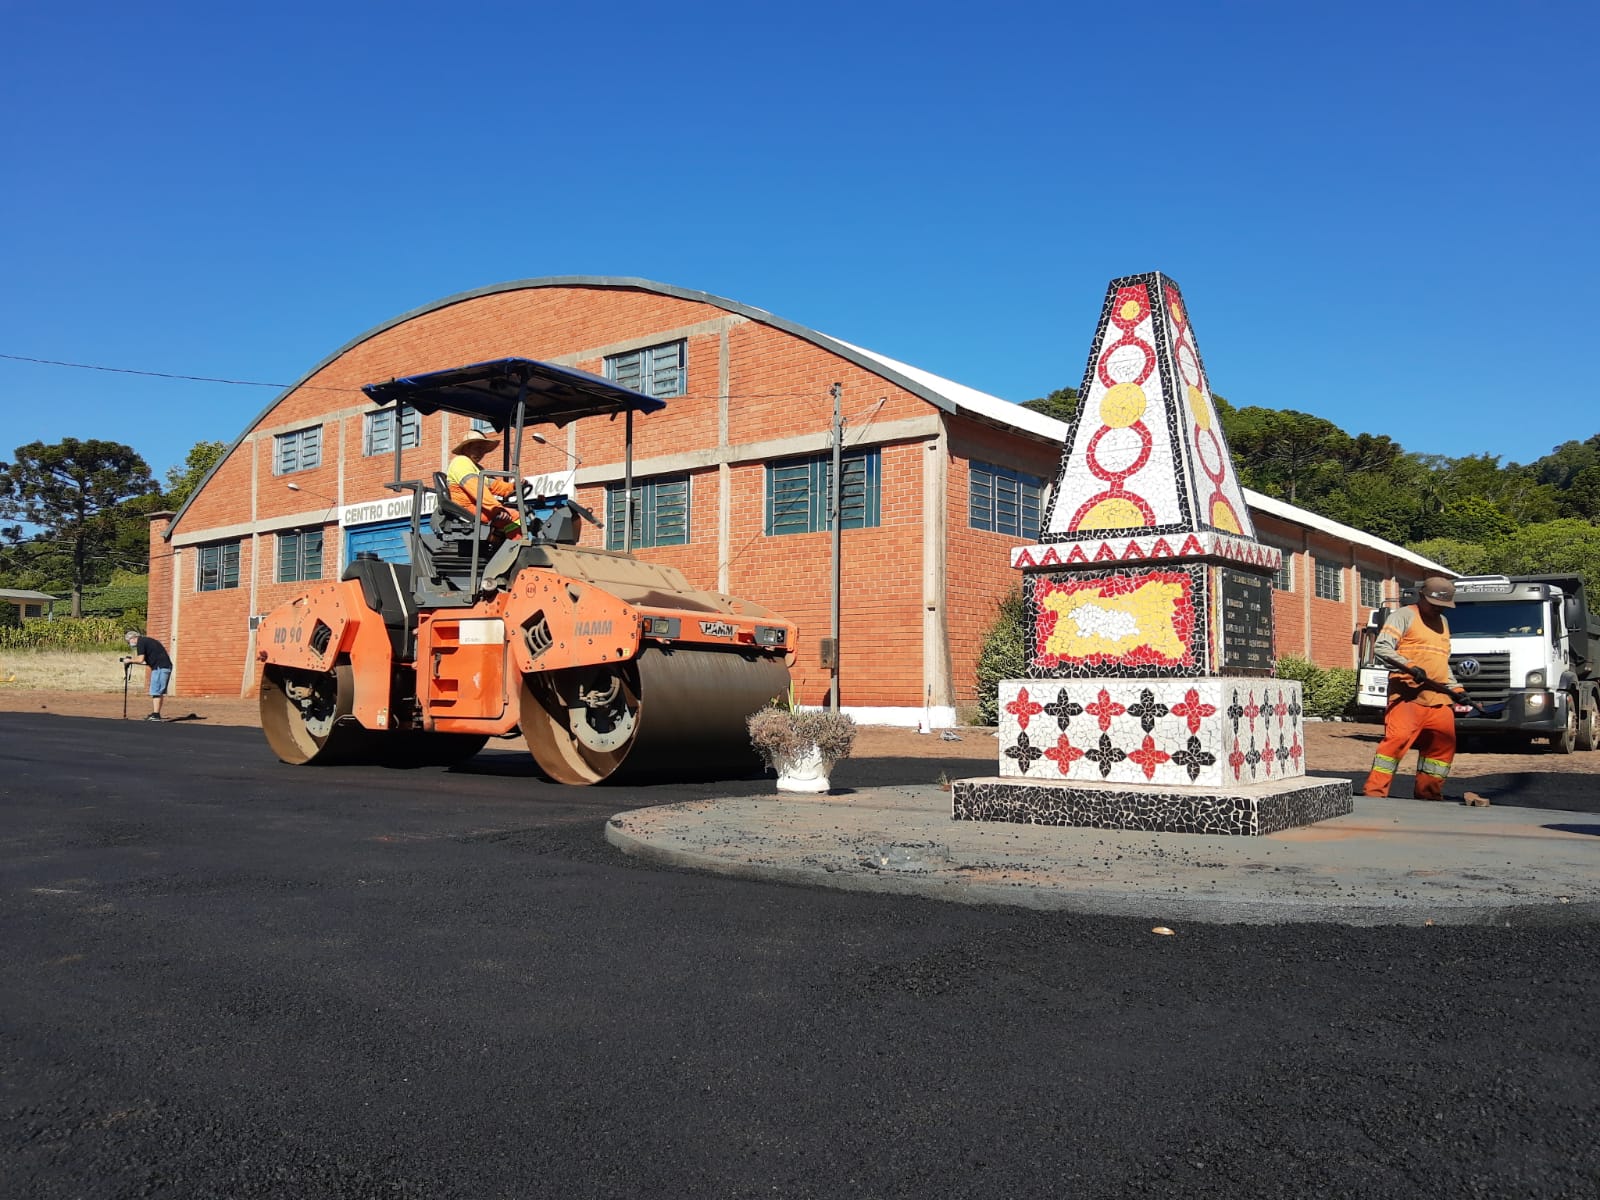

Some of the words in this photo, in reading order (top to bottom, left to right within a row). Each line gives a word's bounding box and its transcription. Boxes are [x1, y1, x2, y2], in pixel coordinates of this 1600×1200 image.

[534, 475, 566, 495] lho
[345, 504, 383, 523] CENTRO
[274, 628, 287, 644] HD
[289, 627, 302, 643] 90
[574, 620, 613, 637] HAMM
[704, 623, 734, 636] HAMM
